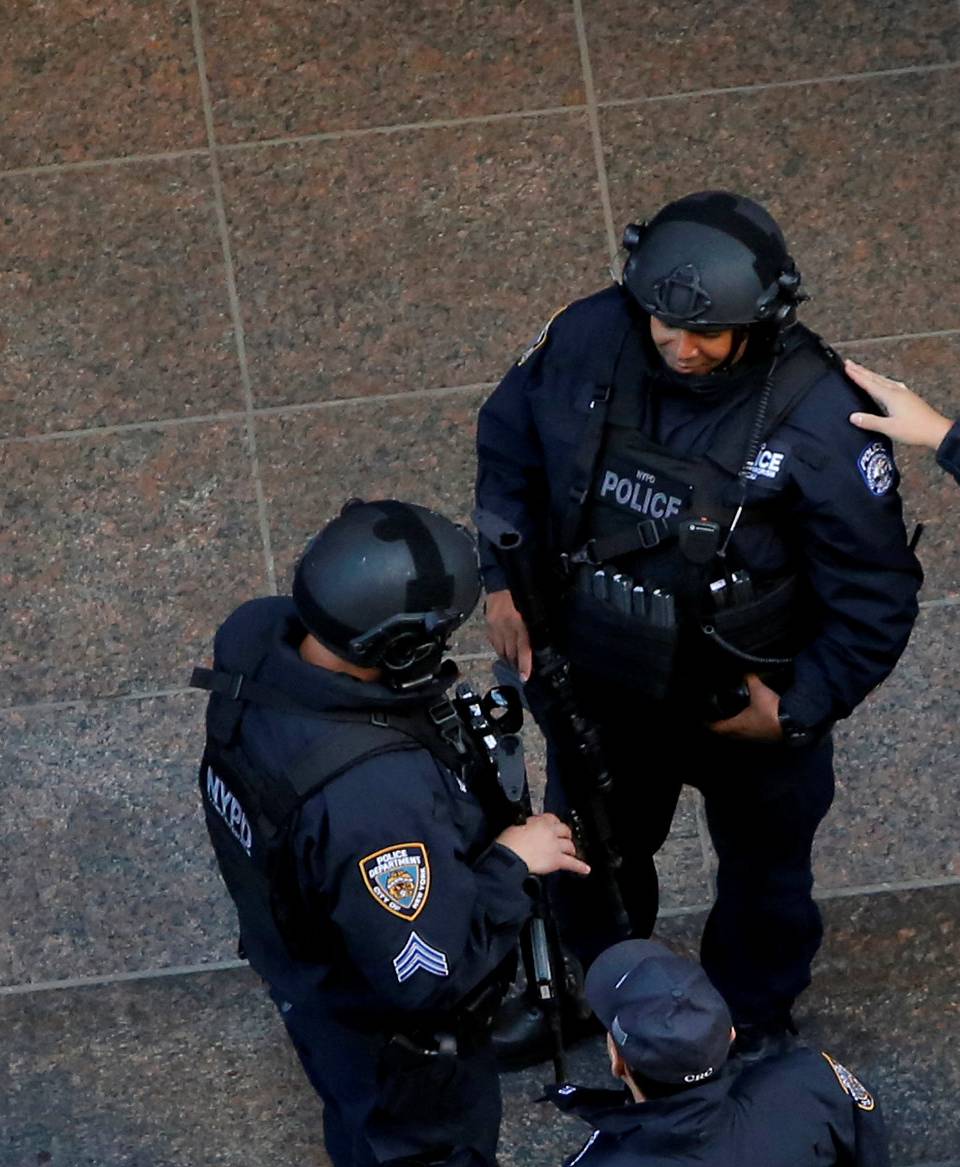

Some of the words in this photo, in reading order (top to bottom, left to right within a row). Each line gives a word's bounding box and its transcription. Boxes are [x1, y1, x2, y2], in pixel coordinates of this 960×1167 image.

[600, 470, 682, 519] POLICE
[206, 765, 252, 848] NYPD
[368, 855, 422, 879] DEPARTMENT
[376, 849, 408, 865] POLICE
